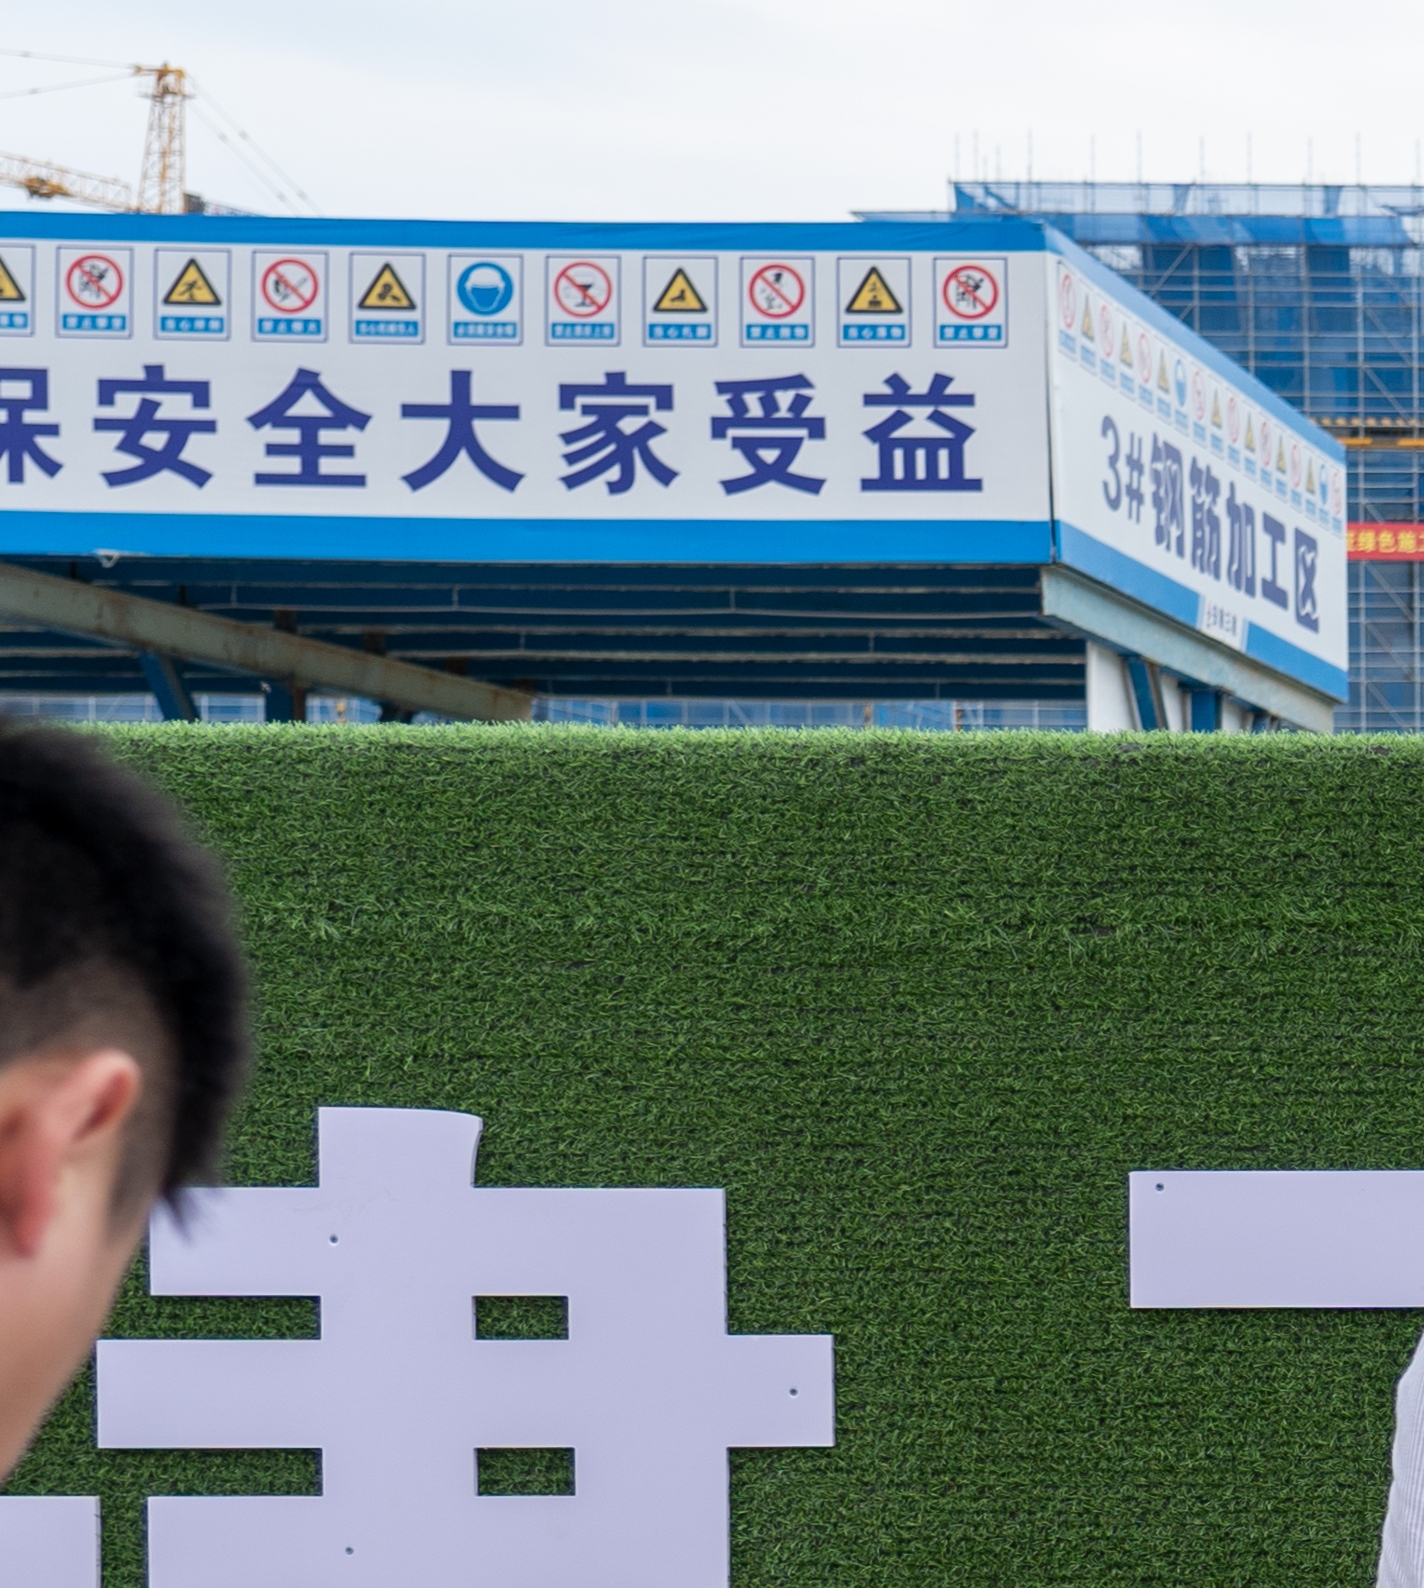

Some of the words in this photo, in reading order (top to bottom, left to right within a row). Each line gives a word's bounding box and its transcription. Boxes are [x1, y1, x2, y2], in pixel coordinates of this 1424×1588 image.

[1101, 415, 1320, 635] 3#钢筋加工区
